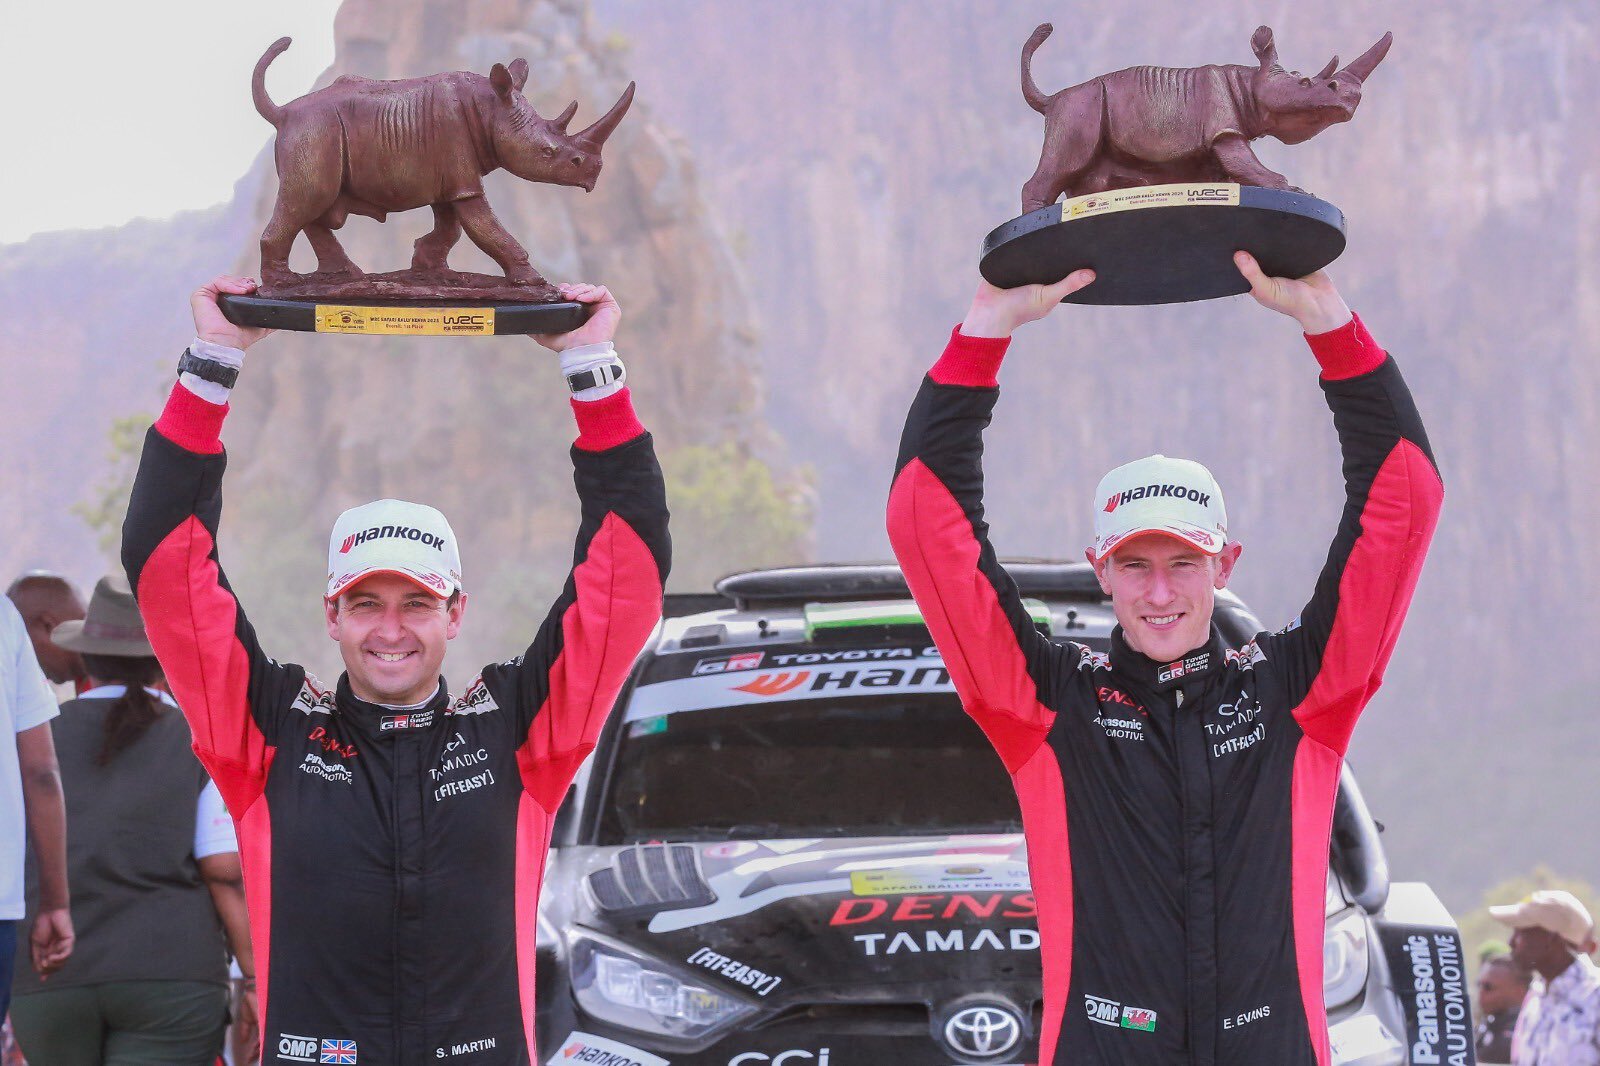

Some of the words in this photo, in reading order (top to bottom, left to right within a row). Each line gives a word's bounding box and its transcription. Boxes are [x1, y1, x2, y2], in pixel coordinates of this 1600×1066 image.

[443, 316, 484, 324] WRC
[697, 656, 758, 674] GR
[772, 648, 913, 665] TOYOTA
[1185, 652, 1210, 664] TOYOTA
[1159, 667, 1183, 682] GR
[381, 720, 407, 730] GR
[411, 710, 435, 719] TOYOTA
[829, 893, 1037, 926] DENS
[854, 928, 1041, 956] TAMAD
[1084, 999, 1119, 1022] OMP
[1403, 934, 1441, 1065] Panasonic
[1434, 933, 1468, 1066] AUTOMOTIVE
[1223, 1017, 1235, 1030] E.
[1236, 1005, 1271, 1026] EVANS
[278, 1037, 318, 1058] OMP
[436, 1047, 448, 1058] S.
[451, 1037, 496, 1056] MARTIN
